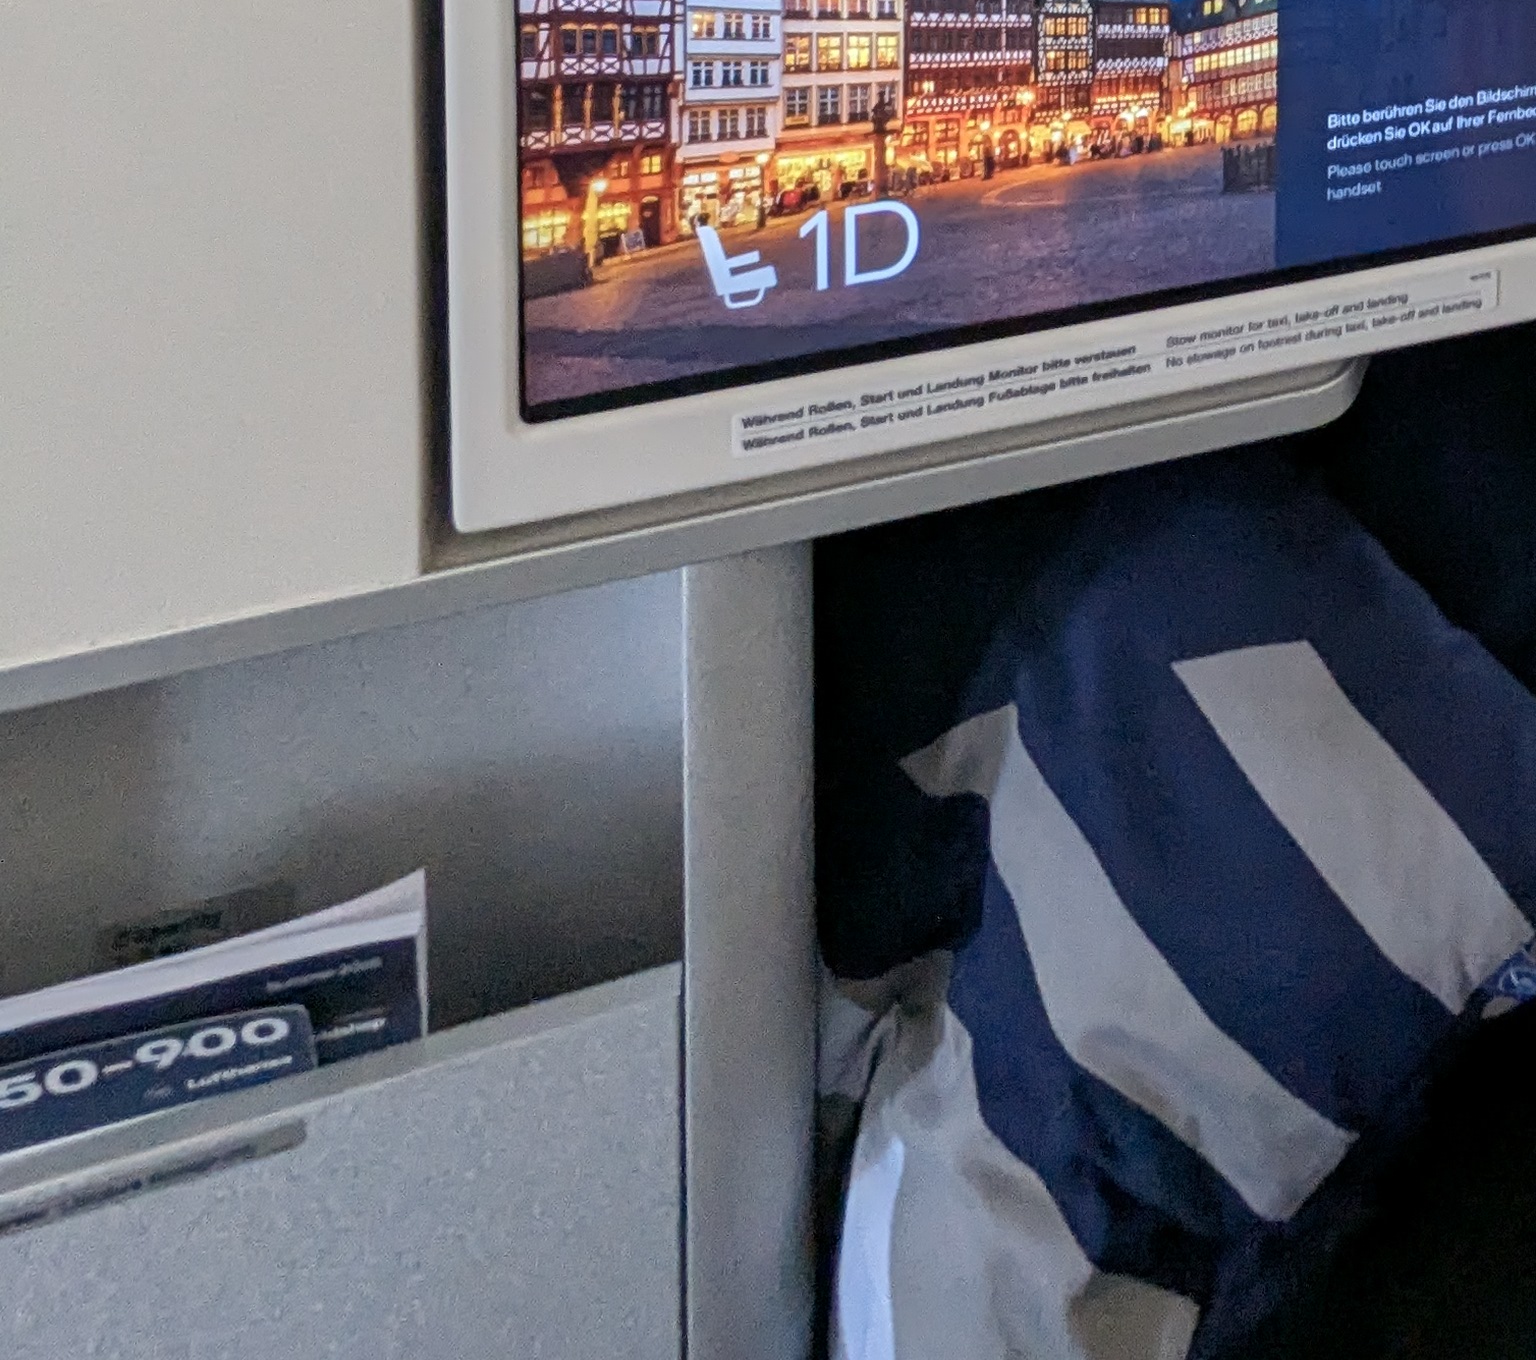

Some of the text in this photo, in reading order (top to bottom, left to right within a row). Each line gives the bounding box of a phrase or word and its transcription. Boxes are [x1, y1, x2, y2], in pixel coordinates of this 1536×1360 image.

[1328, 112, 1360, 129] Bitte
[1362, 103, 1423, 125] berühren
[1425, 98, 1446, 114] Sie
[1448, 94, 1473, 110] den
[1327, 129, 1382, 151] drücken
[1384, 127, 1405, 142] Sie
[1408, 121, 1431, 138] OK
[1432, 118, 1453, 134] auf
[1456, 113, 1485, 130] Ihrer
[1327, 163, 1372, 180] Please
[1375, 155, 1412, 173] touch
[1416, 147, 1460, 165] screen
[1462, 145, 1475, 157] or
[1478, 139, 1514, 157] press
[1515, 132, 1536, 149] OK
[1327, 181, 1382, 202] handset
[799, 200, 920, 291] 1D
